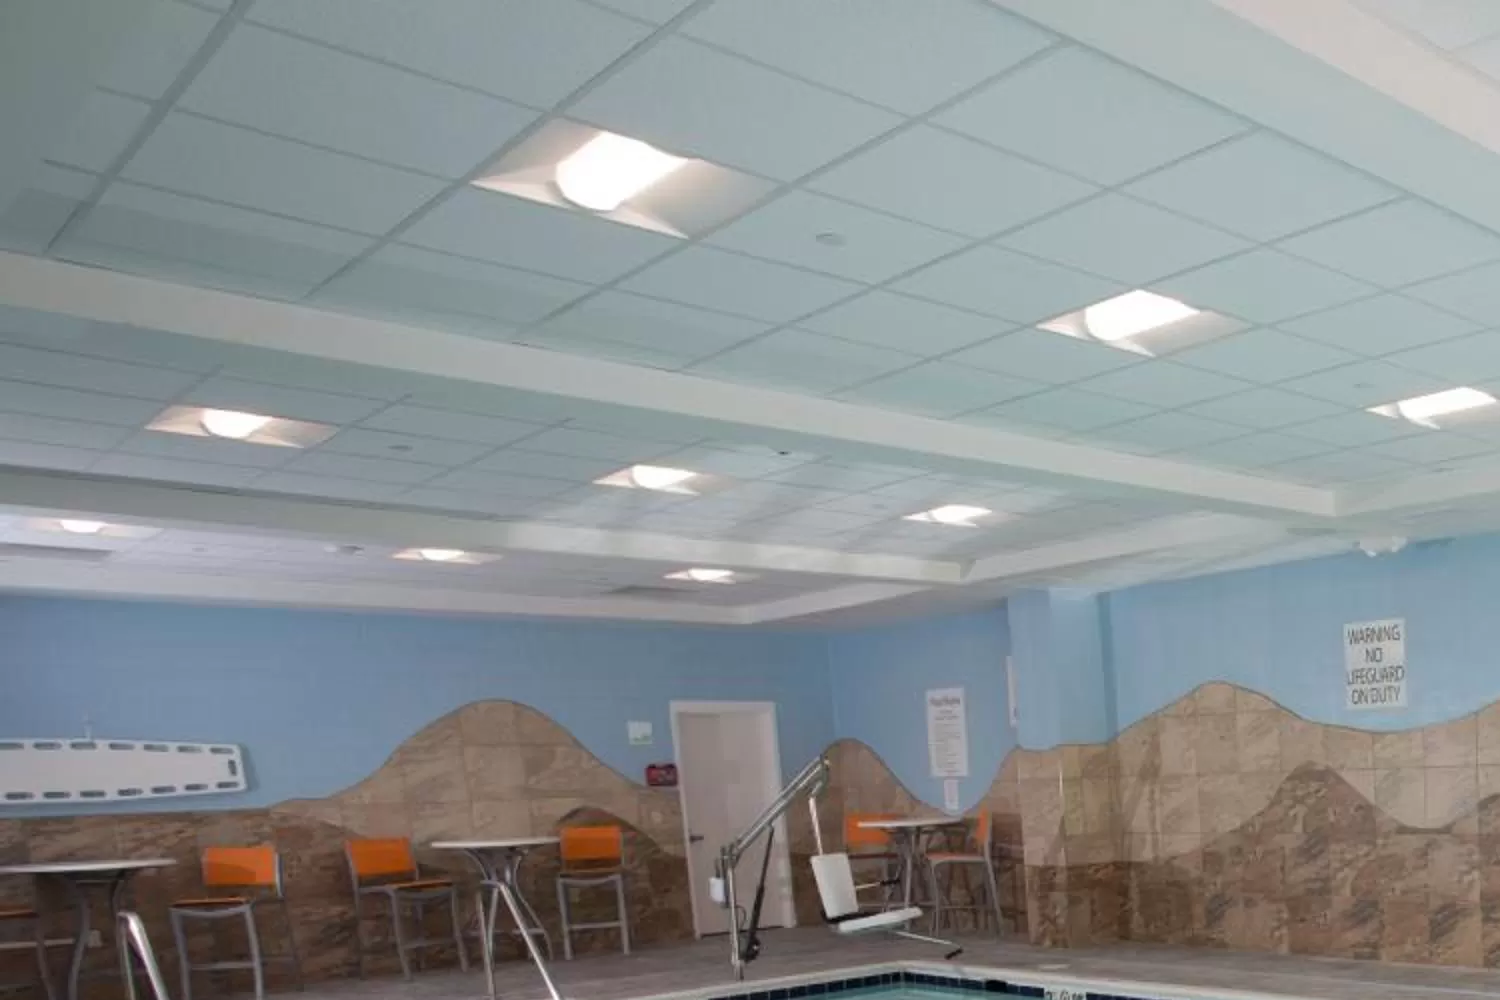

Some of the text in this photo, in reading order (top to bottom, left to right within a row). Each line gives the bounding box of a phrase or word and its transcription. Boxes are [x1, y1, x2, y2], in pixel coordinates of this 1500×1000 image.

[1346, 622, 1401, 645] WARNING
[1364, 646, 1384, 663] NO
[1346, 664, 1405, 686] LIFEGUARD
[1350, 684, 1401, 705] ON DUTY
